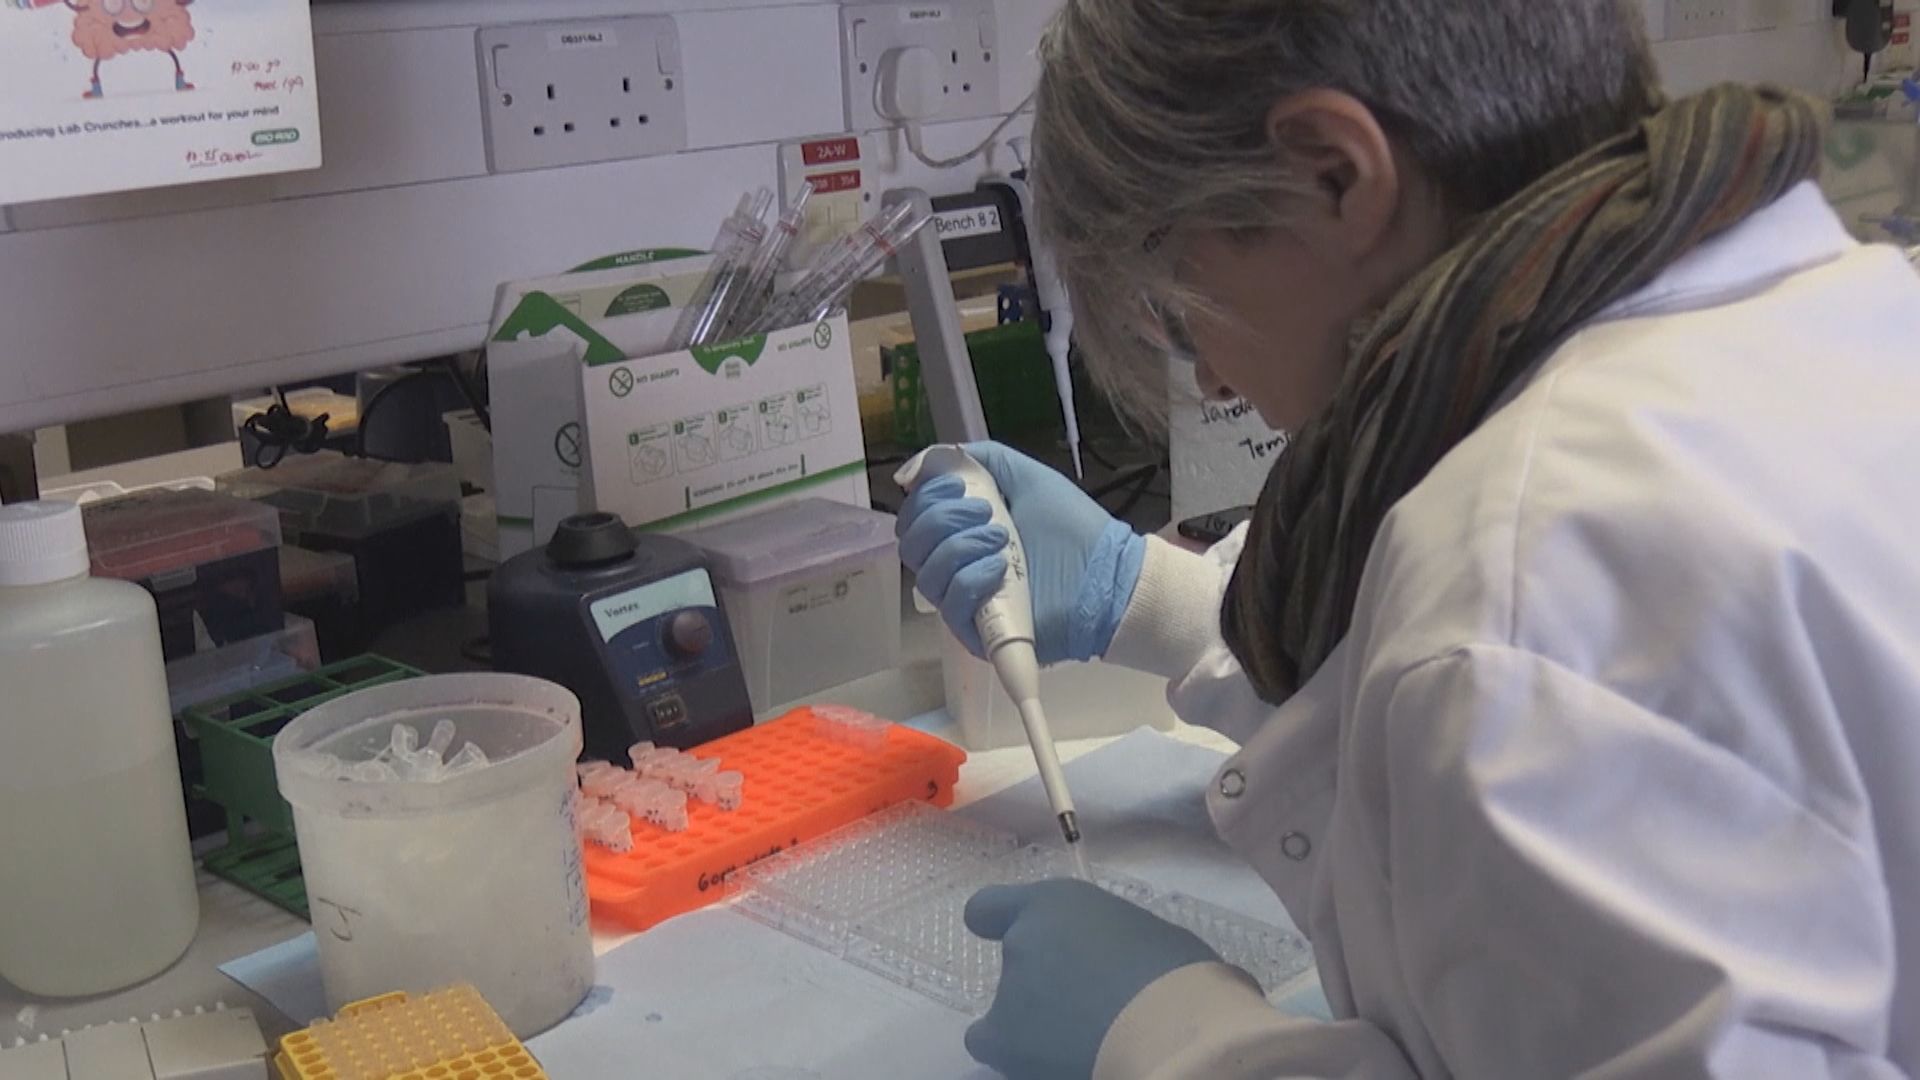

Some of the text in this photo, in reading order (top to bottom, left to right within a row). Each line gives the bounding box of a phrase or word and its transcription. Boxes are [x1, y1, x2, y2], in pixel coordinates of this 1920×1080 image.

[57, 123, 81, 135] Lab
[159, 112, 206, 126] workout
[207, 109, 223, 121] for
[226, 109, 250, 121] your
[252, 105, 280, 117] mind
[816, 143, 846, 160] 2A-W
[934, 214, 976, 233] Bench
[988, 210, 998, 226] 2
[615, 251, 655, 265] HANDLE
[636, 368, 679, 384] NO SHARPS
[604, 602, 639, 619] Vortex
